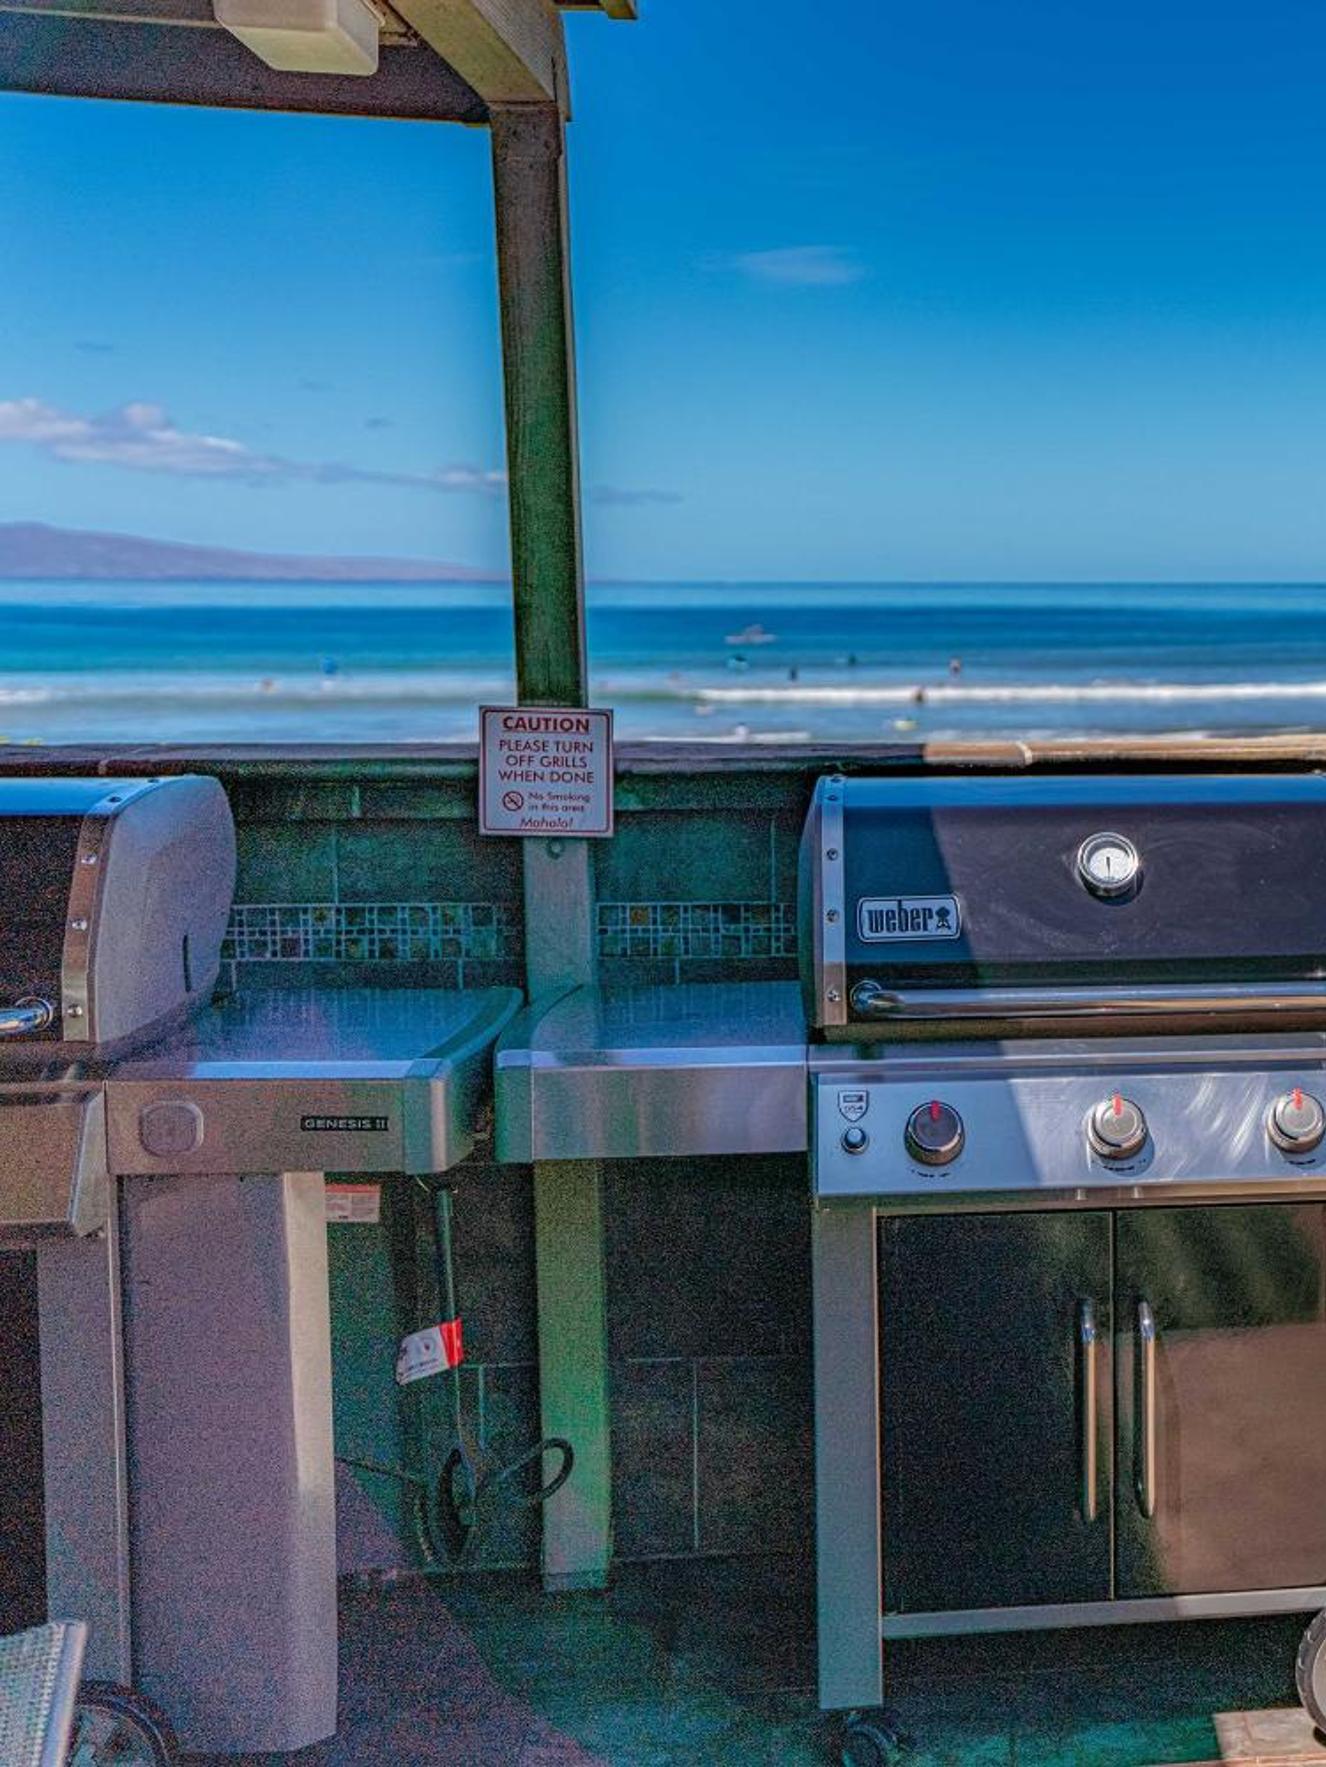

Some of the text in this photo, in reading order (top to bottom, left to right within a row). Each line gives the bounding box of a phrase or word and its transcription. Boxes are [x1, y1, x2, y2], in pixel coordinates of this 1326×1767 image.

[502, 716, 589, 732] CAUTION
[499, 740, 593, 753] PLEASE TURN
[505, 755, 588, 768] OFF GRILLS
[498, 770, 595, 783] WHEN DONE
[528, 792, 591, 803] No Smoking
[867, 900, 934, 933] weber
[305, 1119, 371, 1129] GENESIS
